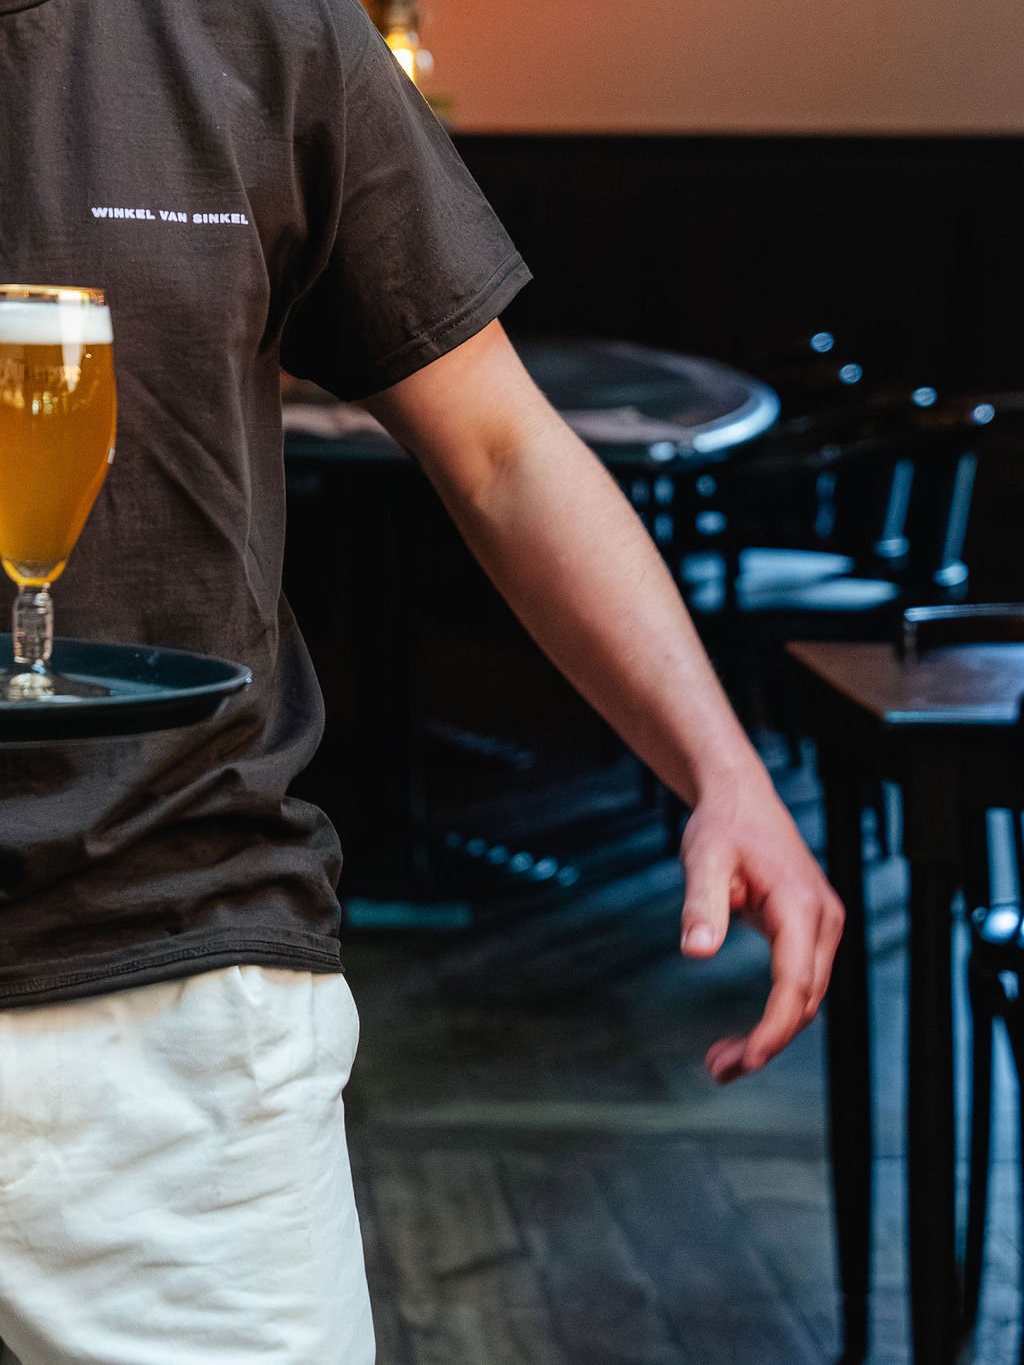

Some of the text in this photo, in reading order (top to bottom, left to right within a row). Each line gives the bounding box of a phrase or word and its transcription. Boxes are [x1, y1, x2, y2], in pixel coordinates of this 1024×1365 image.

[91, 207, 249, 225] WINKEL VAN SINKEL
